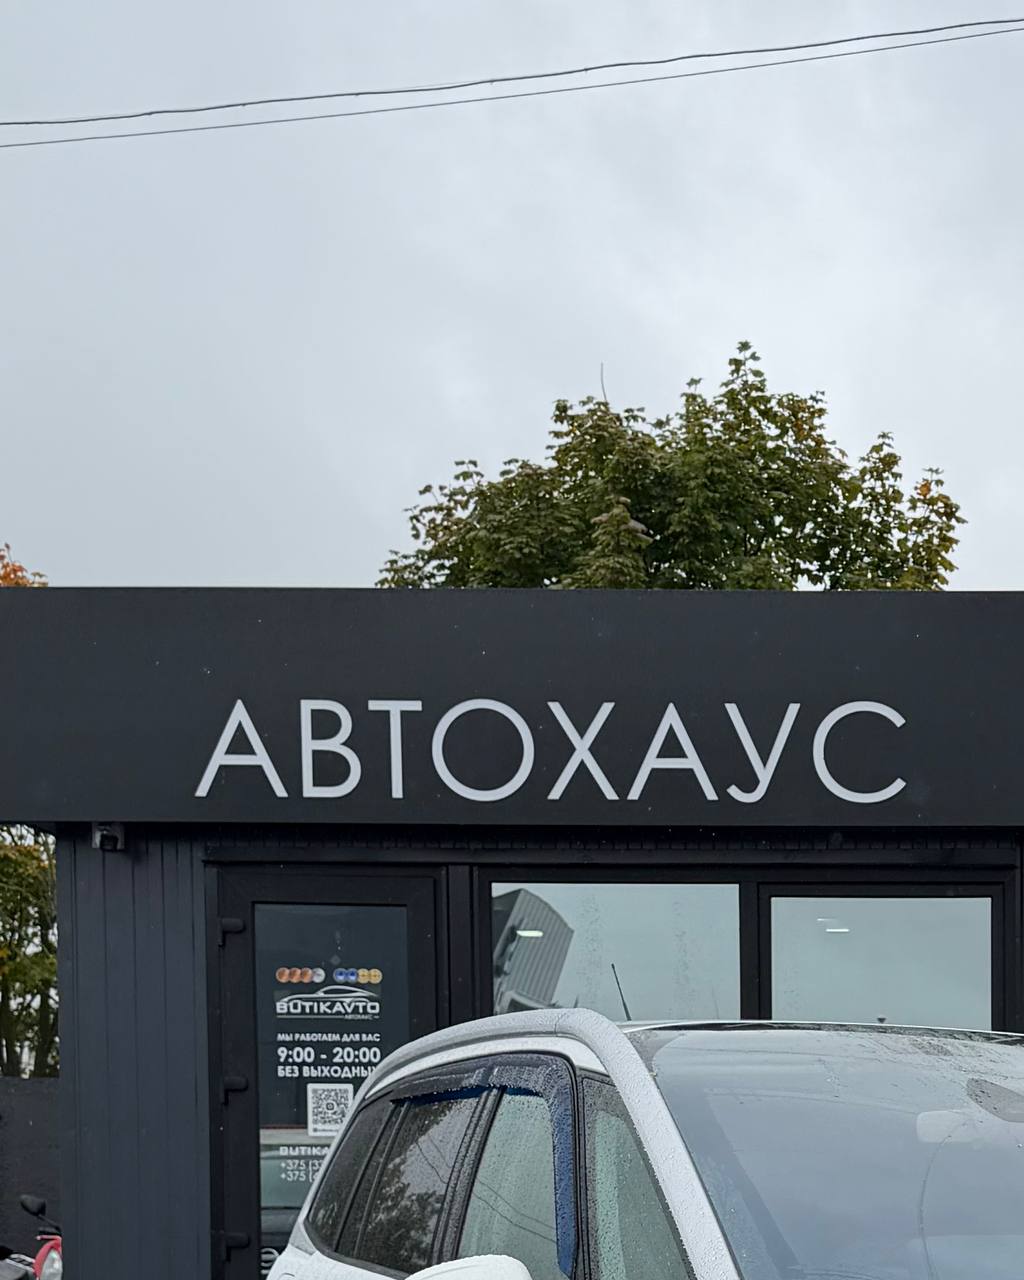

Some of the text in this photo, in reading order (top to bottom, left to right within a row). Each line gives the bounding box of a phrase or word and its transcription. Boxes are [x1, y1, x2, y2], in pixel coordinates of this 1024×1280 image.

[194, 697, 907, 805] АВТОХАУС
[276, 1001, 380, 1014] BUTIKAVTO
[276, 1033, 381, 1043] МЫ РАБОТАЕМ ДЛЯ ВАС
[276, 1046, 315, 1063] 9:00
[332, 1047, 381, 1063] 20:00
[277, 1065, 299, 1078] БЕЗ
